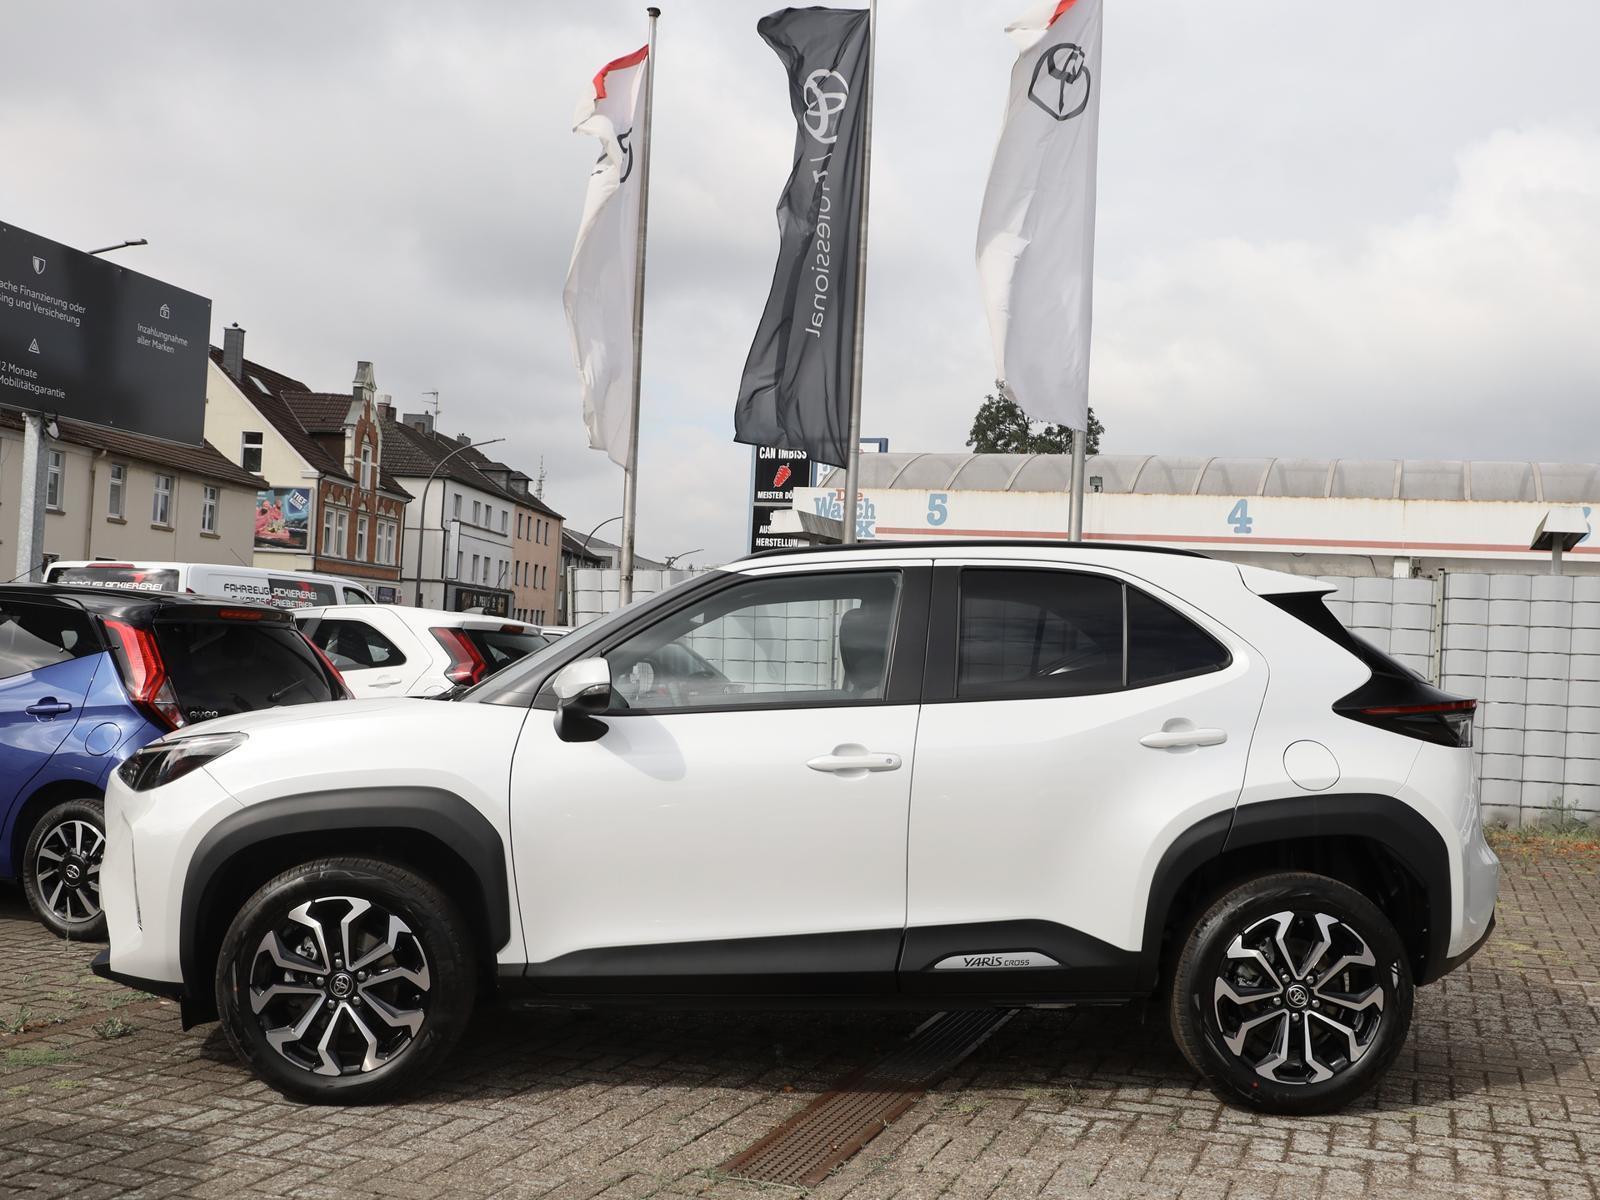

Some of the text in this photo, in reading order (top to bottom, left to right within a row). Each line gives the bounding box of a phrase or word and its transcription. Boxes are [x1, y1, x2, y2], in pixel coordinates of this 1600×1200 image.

[20, 284, 68, 311] Finanzierung
[69, 302, 86, 314] oder
[16, 299, 31, 310] und
[33, 302, 81, 328] Versicherung
[137, 336, 175, 354] aller Marken
[8, 363, 38, 379] Monate
[760, 446, 808, 459] CAN IMBISS
[757, 490, 783, 499] MEISTER
[836, 489, 864, 502] De
[814, 493, 876, 520] Wach
[927, 493, 948, 526] 5
[1227, 499, 1253, 534] 4
[1003, 959, 1030, 967] CROSS
